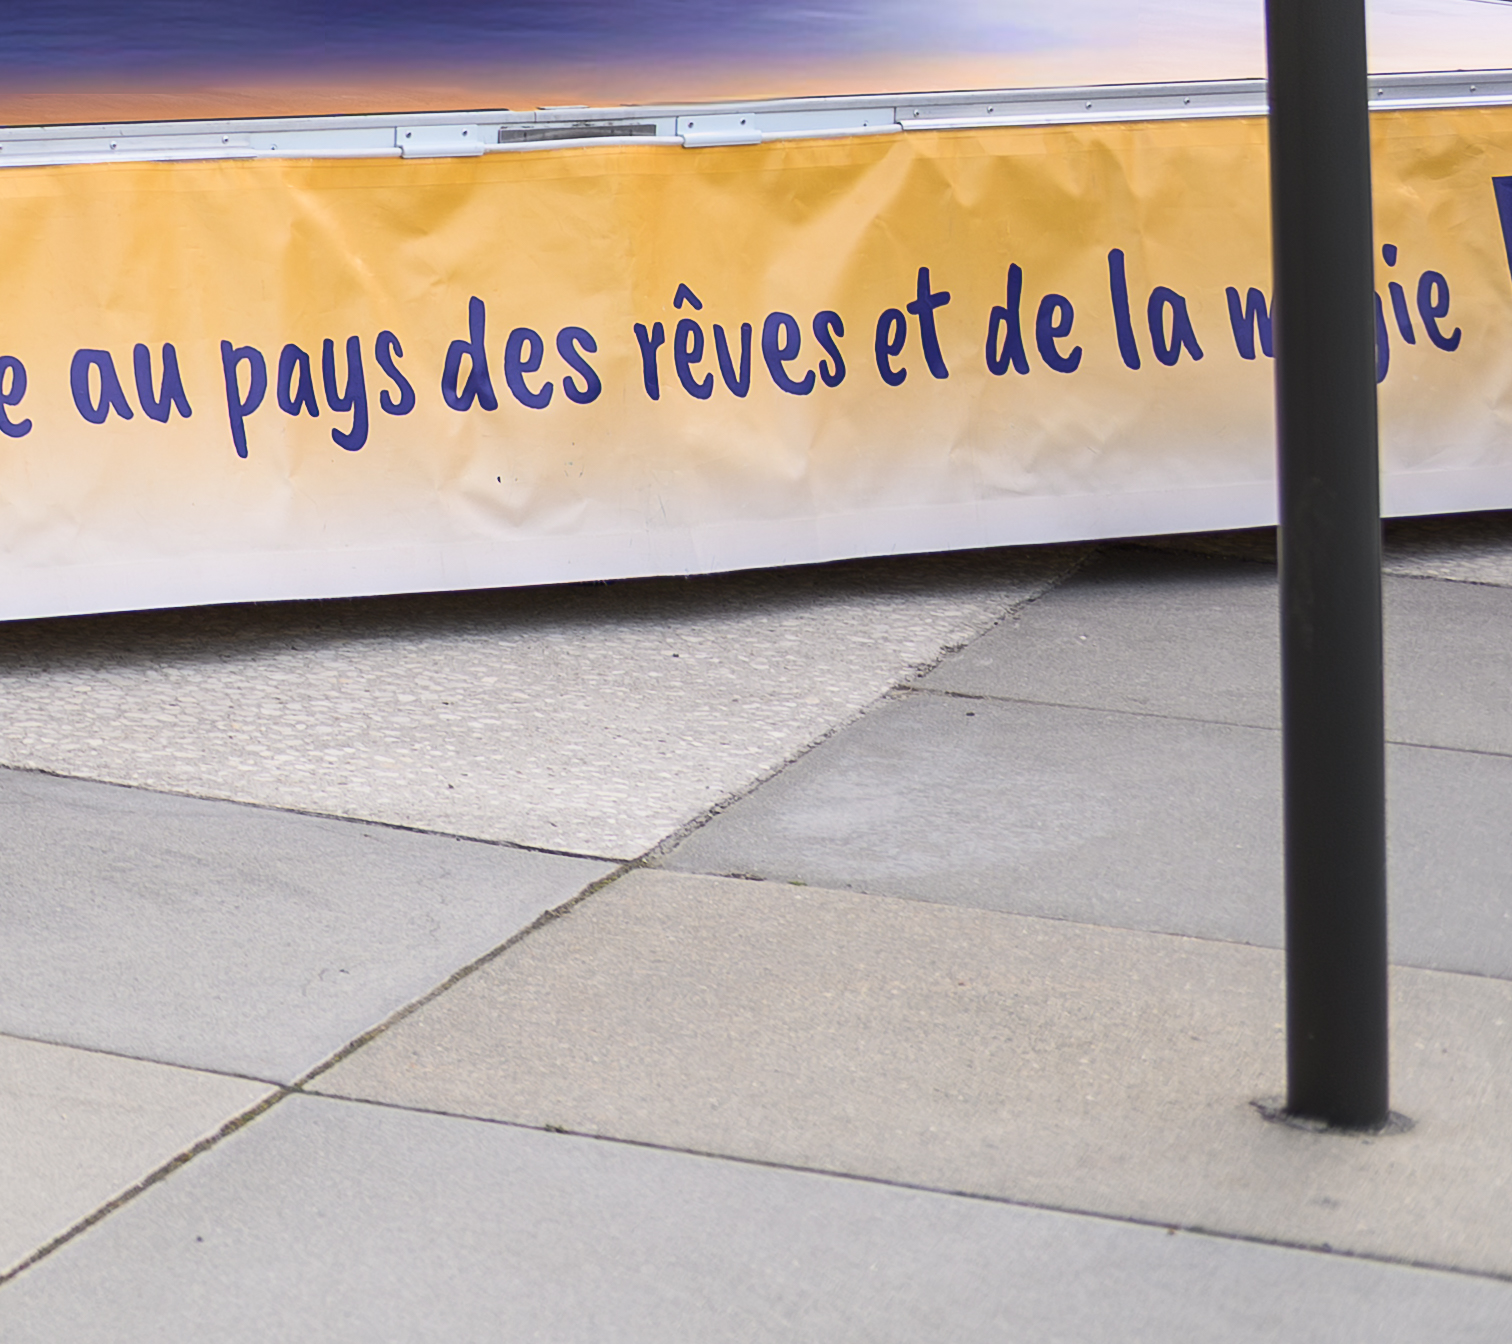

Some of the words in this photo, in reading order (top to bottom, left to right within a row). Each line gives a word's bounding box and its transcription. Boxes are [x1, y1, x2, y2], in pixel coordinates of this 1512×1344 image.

[69, 340, 193, 425] au
[220, 329, 417, 461] pays
[440, 294, 603, 412] des
[633, 282, 848, 402] rêves
[873, 265, 952, 387] et
[983, 261, 1083, 377] de
[1107, 247, 1205, 372] la
